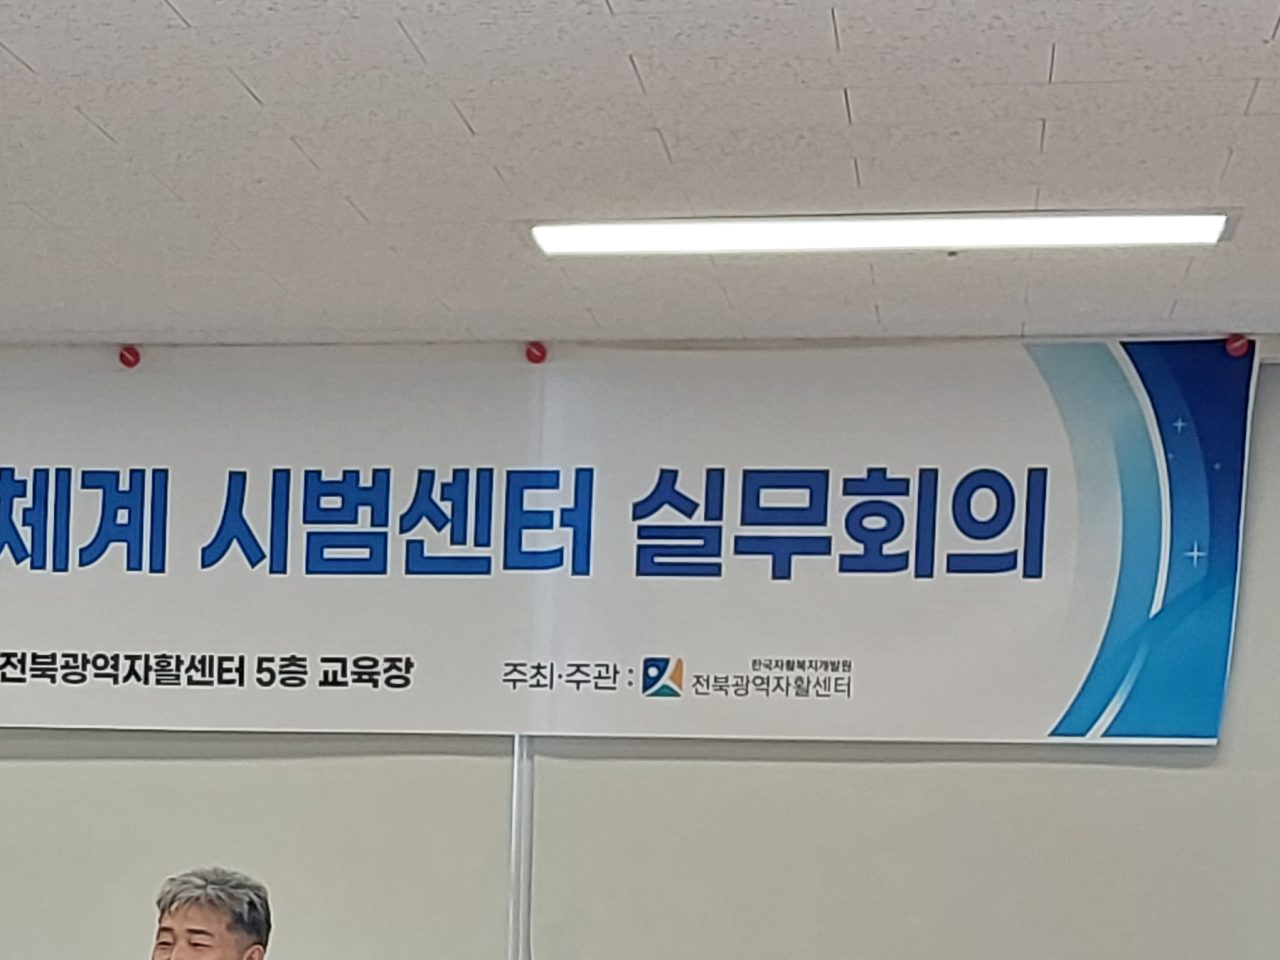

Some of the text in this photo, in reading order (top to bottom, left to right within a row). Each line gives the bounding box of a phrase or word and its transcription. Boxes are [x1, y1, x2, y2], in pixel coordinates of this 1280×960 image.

[200, 466, 595, 578] 시범센터
[631, 466, 1048, 580] 실무회의
[255, 655, 309, 687] 5층
[318, 655, 415, 688] 교육장
[751, 658, 852, 673] 한국자활복지개발원
[692, 674, 852, 698] 전북광역자활센터
